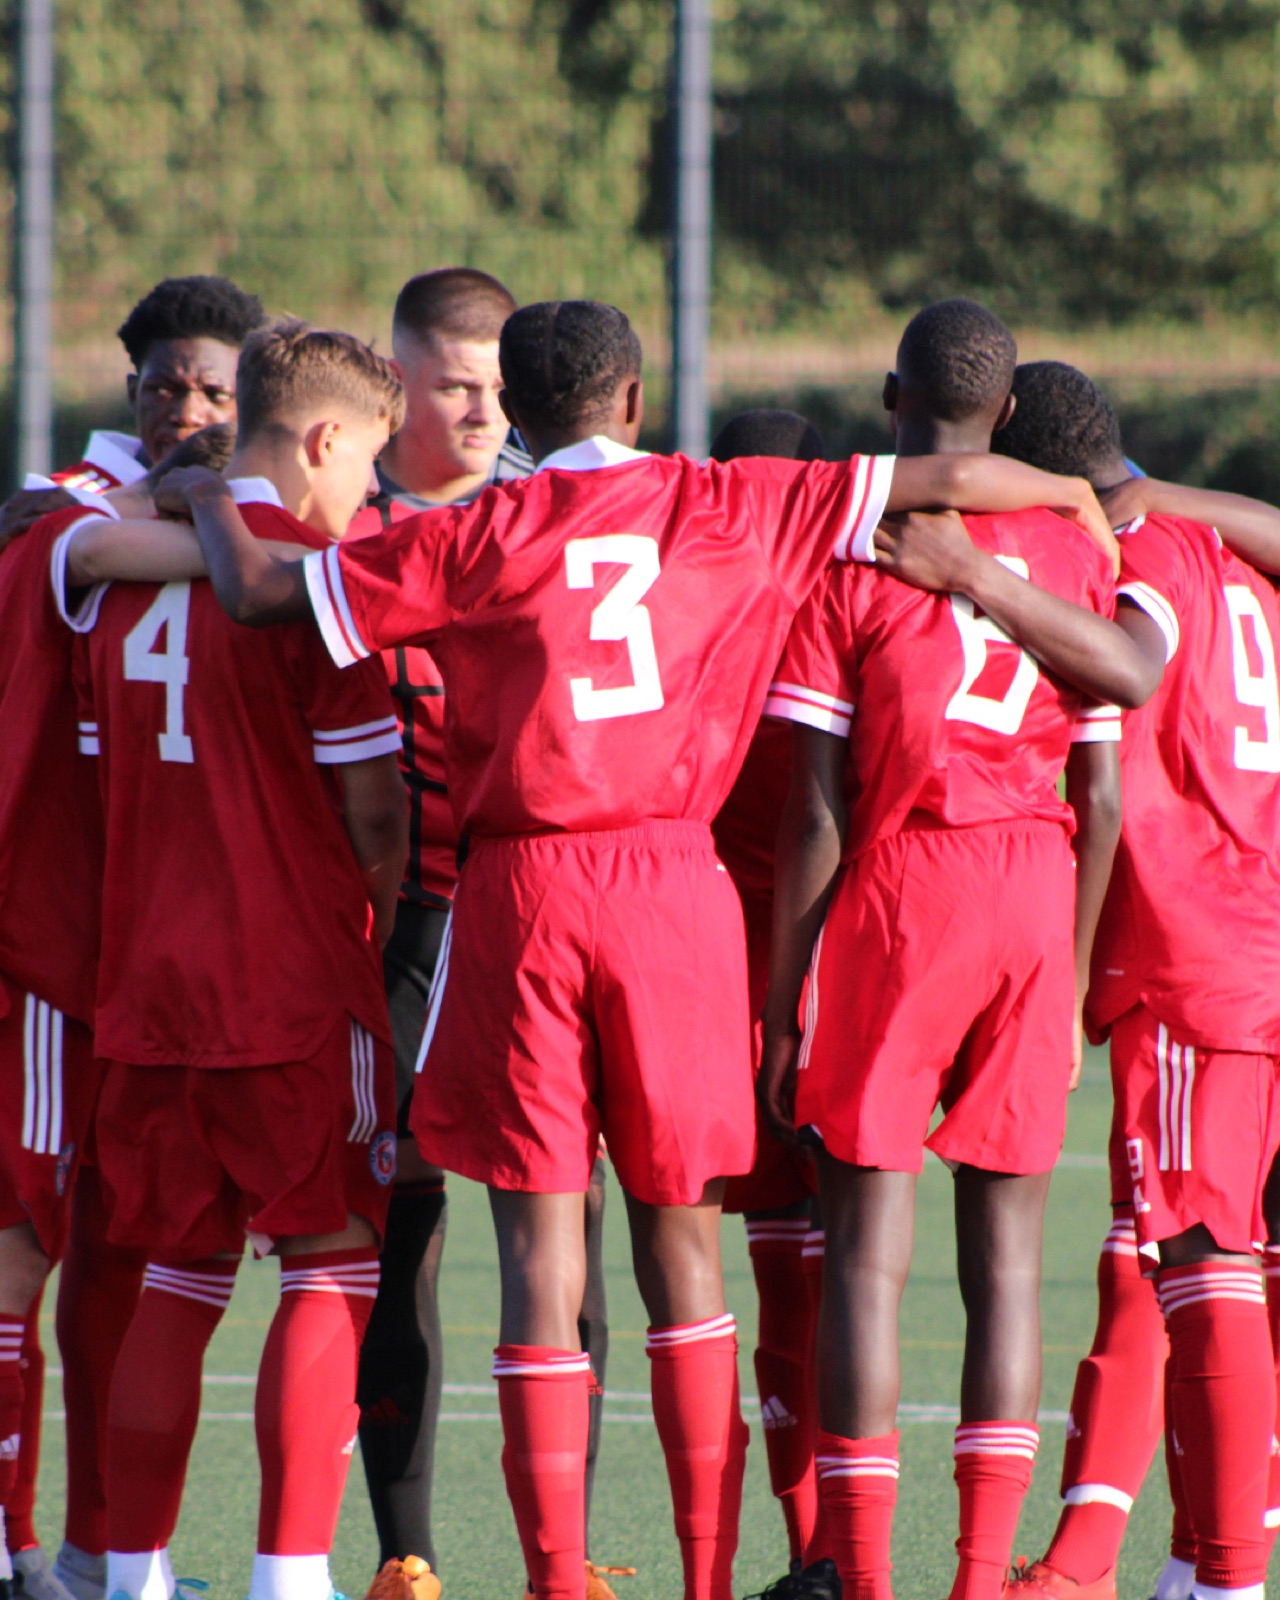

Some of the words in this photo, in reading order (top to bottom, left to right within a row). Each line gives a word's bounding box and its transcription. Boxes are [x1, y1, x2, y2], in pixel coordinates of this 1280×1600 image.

[123, 581, 195, 763] 4
[564, 534, 665, 722] 3
[945, 555, 1039, 736] 6
[1223, 585, 1280, 773] 9
[1126, 1138, 1144, 1181] 9
